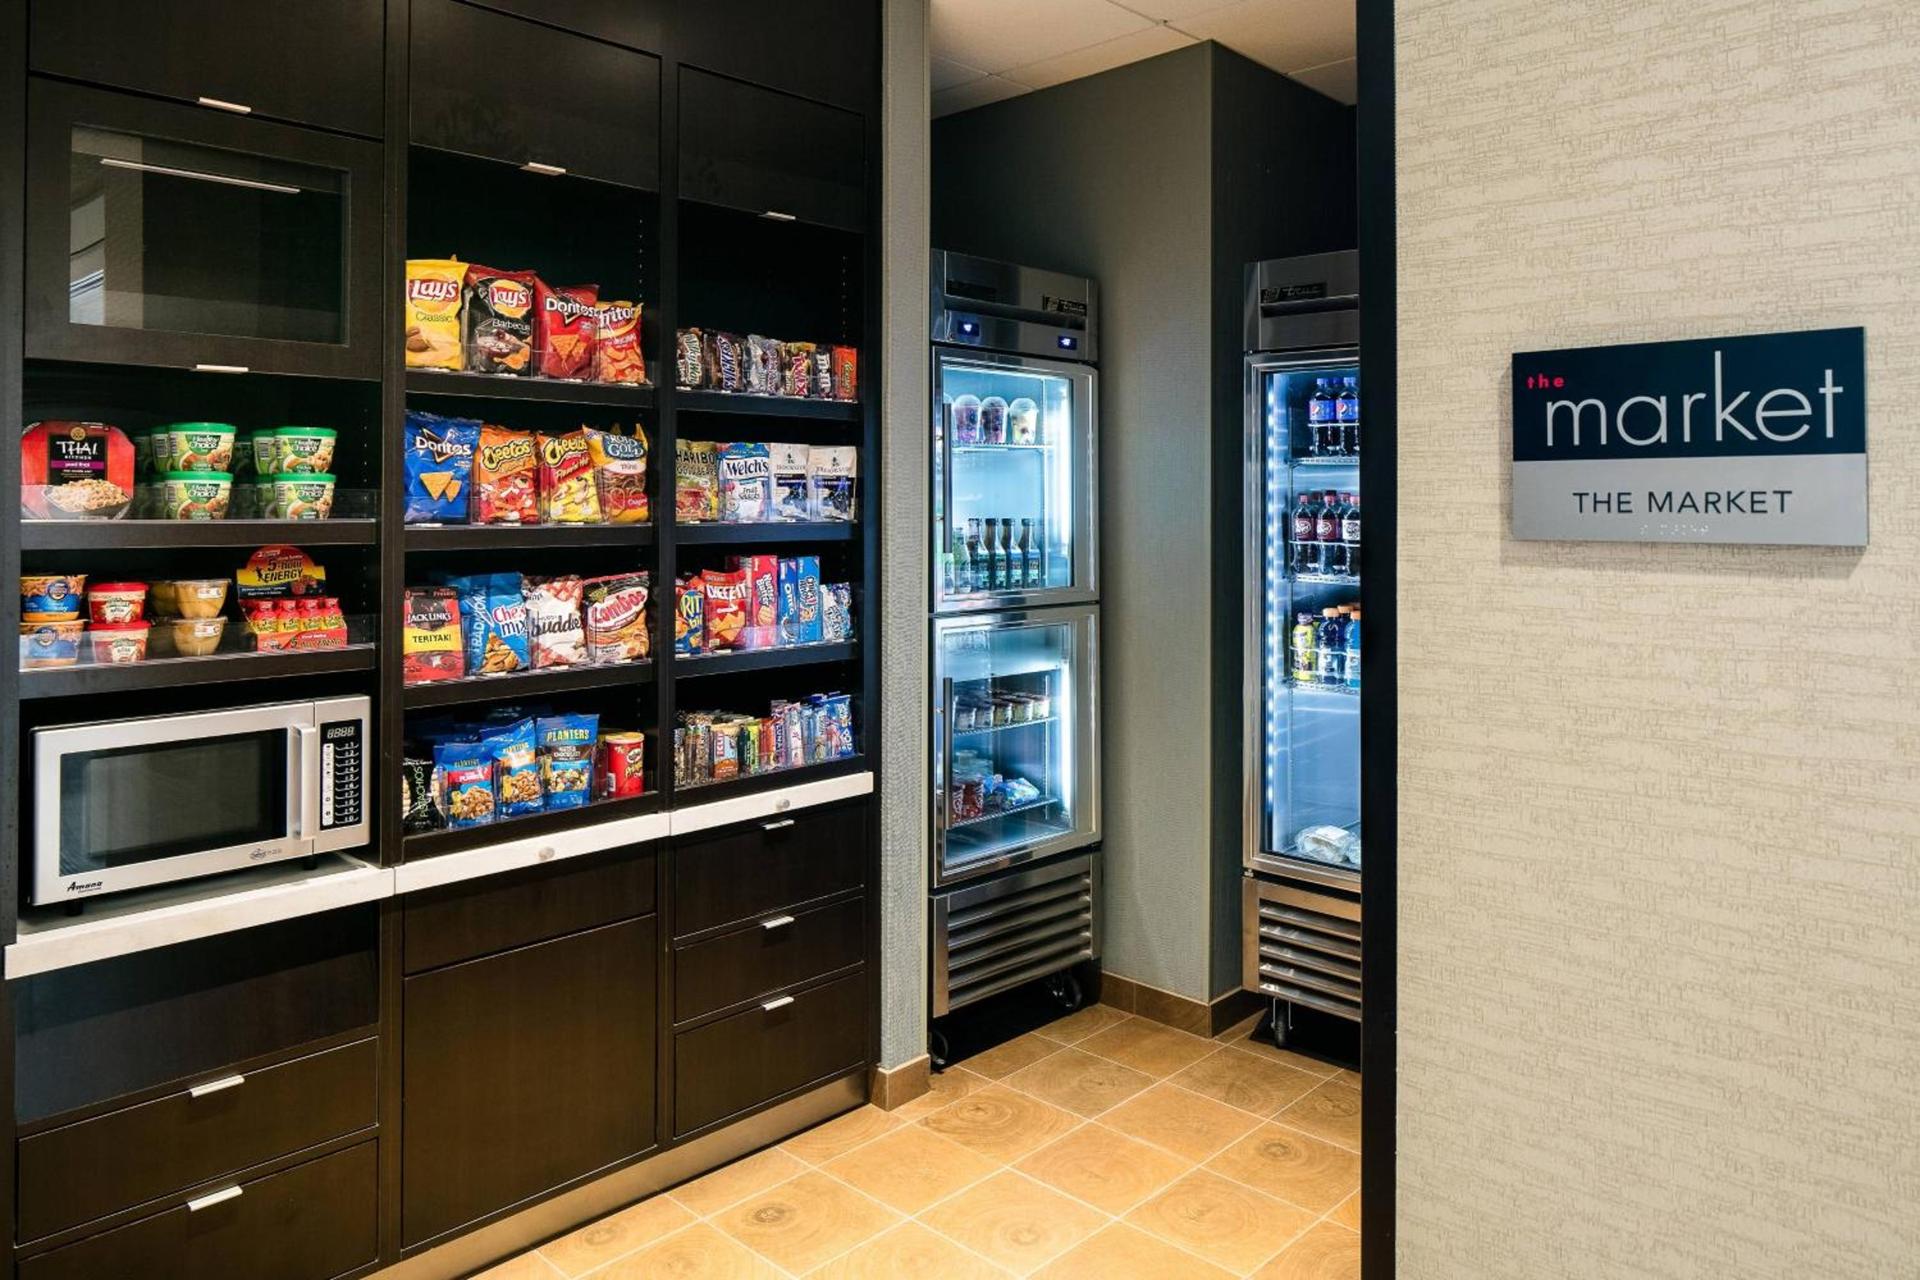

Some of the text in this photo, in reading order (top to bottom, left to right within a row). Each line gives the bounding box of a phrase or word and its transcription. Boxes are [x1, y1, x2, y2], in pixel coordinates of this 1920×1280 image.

[411, 280, 458, 302] Lay's
[493, 286, 528, 308] Lay's
[416, 311, 453, 323] Classic
[1527, 374, 1565, 390] the
[1546, 350, 1844, 447] market
[56, 441, 98, 455] THAI
[416, 436, 471, 455] Doritos
[608, 444, 644, 458] GOLD
[676, 451, 716, 465] HARIBO
[726, 459, 769, 476] Welch's
[1573, 490, 1793, 514] THE MARKET
[265, 568, 304, 582] ENERGY
[591, 591, 645, 623] Combos
[412, 634, 452, 643] TERIYAKI
[547, 729, 590, 742] PLANTERS
[716, 732, 724, 756] CLIF
[415, 766, 428, 818] PISTACHIOS
[67, 881, 103, 891] Amana
